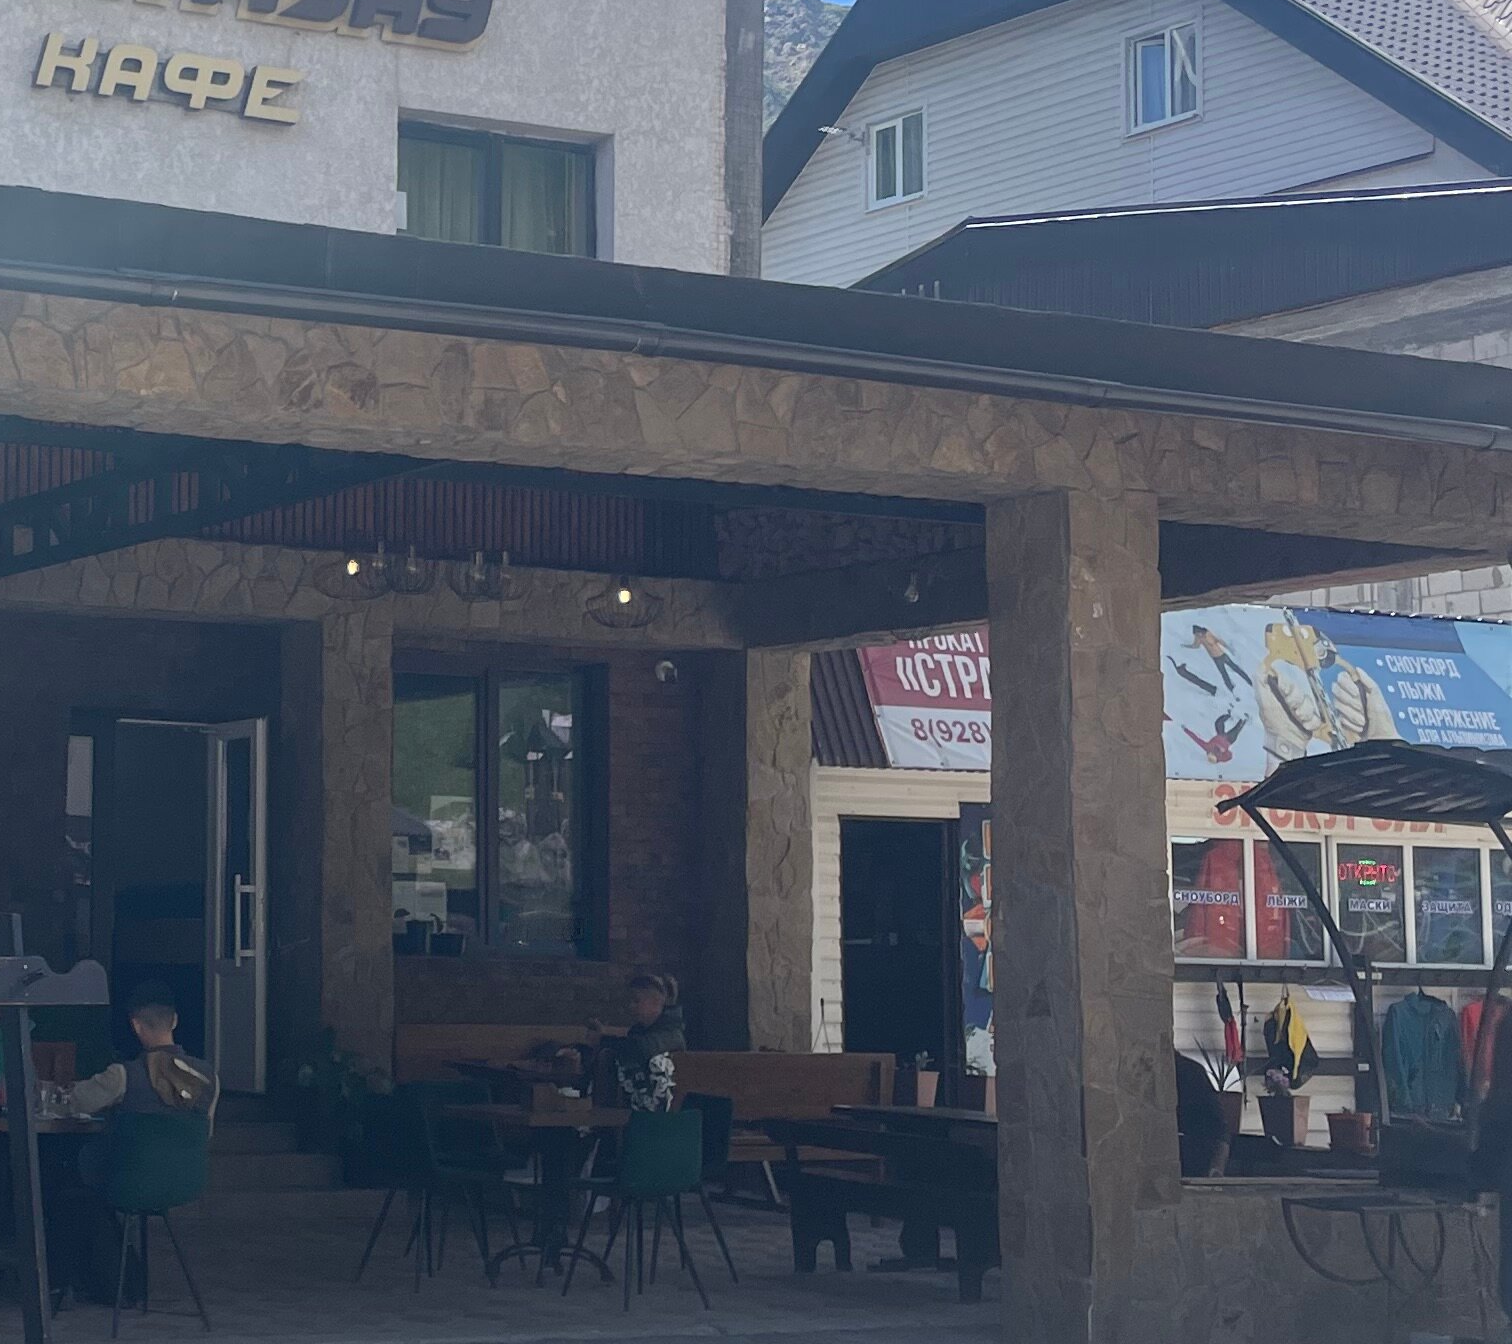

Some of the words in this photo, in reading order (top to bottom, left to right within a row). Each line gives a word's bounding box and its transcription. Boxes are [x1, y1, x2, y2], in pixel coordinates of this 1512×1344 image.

[32, 32, 305, 126] КАФЕ
[1385, 655, 1461, 679] СНОУБОРД
[1397, 681, 1446, 702] ЛЫЖИ
[1408, 707, 1501, 731] СНАРЯЖЕНИЕ
[1173, 890, 1239, 905] СНОУБОРД
[1267, 895, 1306, 907] ЛЫЖИ
[1349, 899, 1391, 911] МАСКИ
[1421, 901, 1473, 914] ЗАЩИТА
